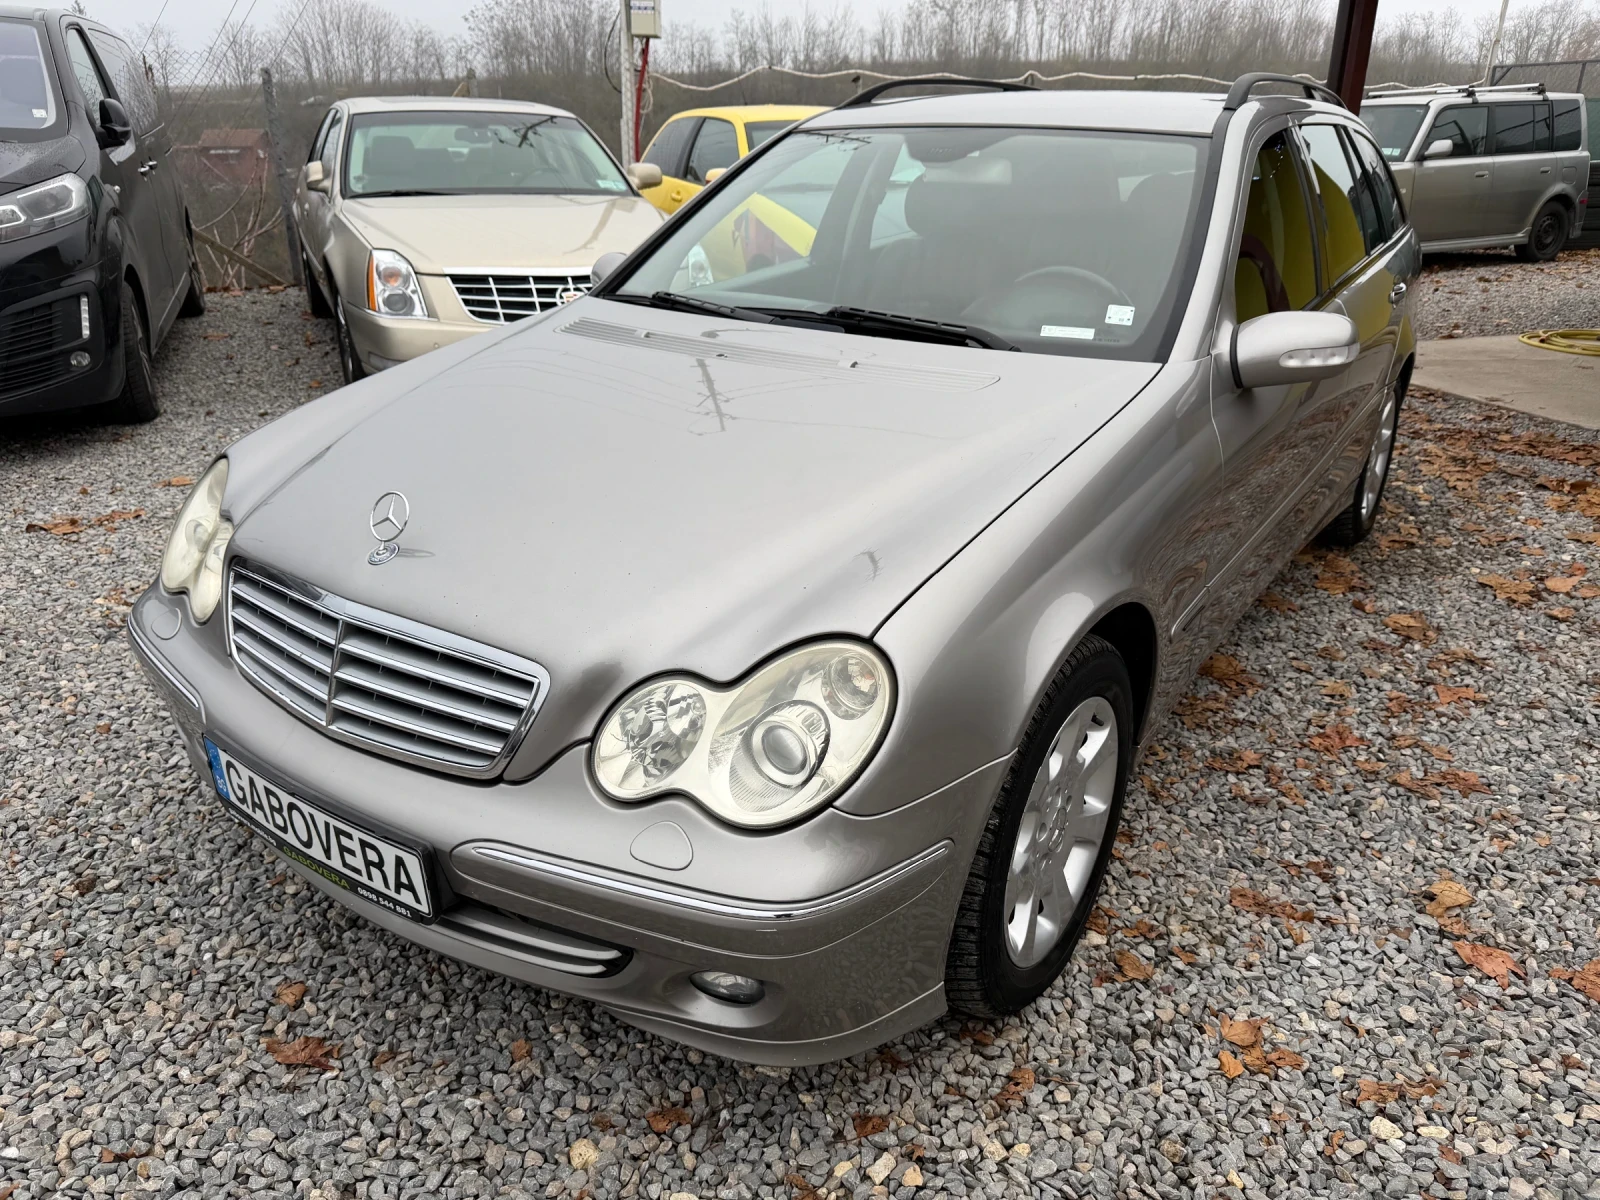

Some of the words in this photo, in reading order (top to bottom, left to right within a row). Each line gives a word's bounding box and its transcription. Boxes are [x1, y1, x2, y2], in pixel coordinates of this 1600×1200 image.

[225, 759, 423, 906] GABOVERA
[283, 846, 350, 889] GABOVERA
[357, 886, 377, 901] 0898
[378, 896, 394, 909] 544
[395, 905, 411, 917] 881
